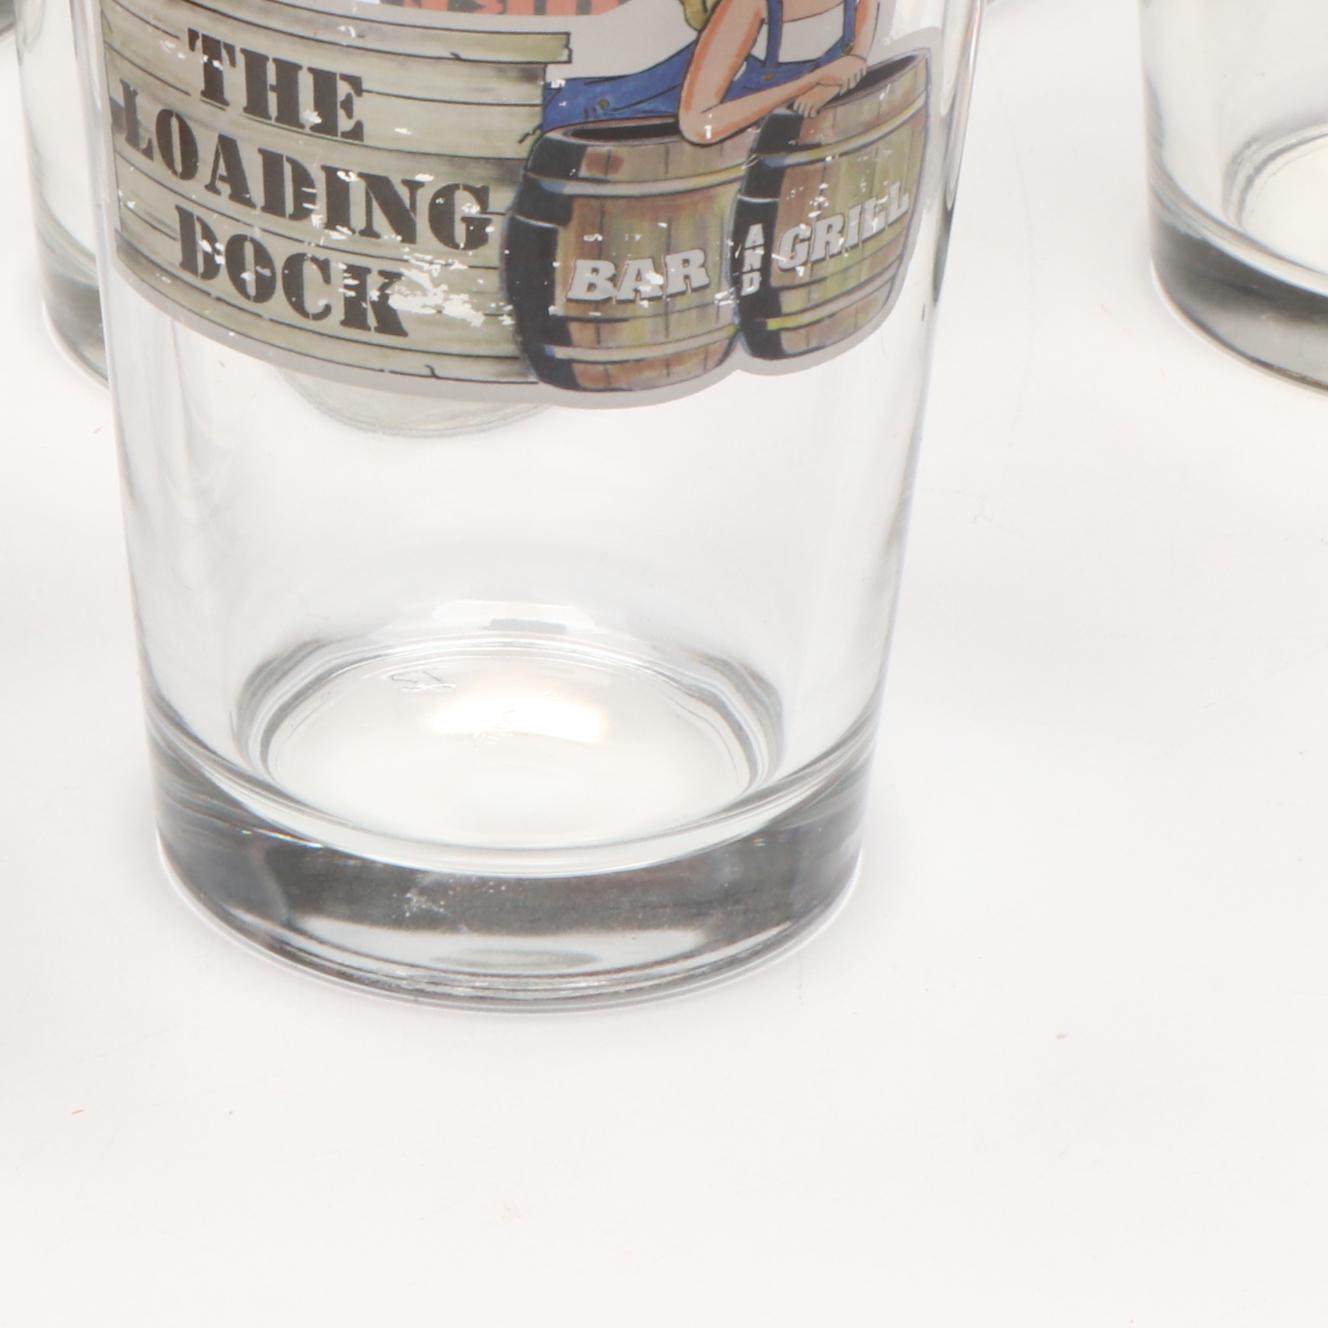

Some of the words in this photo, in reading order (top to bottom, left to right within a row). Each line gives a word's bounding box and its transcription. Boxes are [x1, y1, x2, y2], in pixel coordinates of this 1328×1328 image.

[187, 29, 366, 143] THE
[118, 76, 494, 252] LOADING
[174, 201, 410, 338] DOCK
[567, 247, 711, 304] BAR
[740, 223, 767, 297] AND
[774, 180, 910, 272] GRILL
